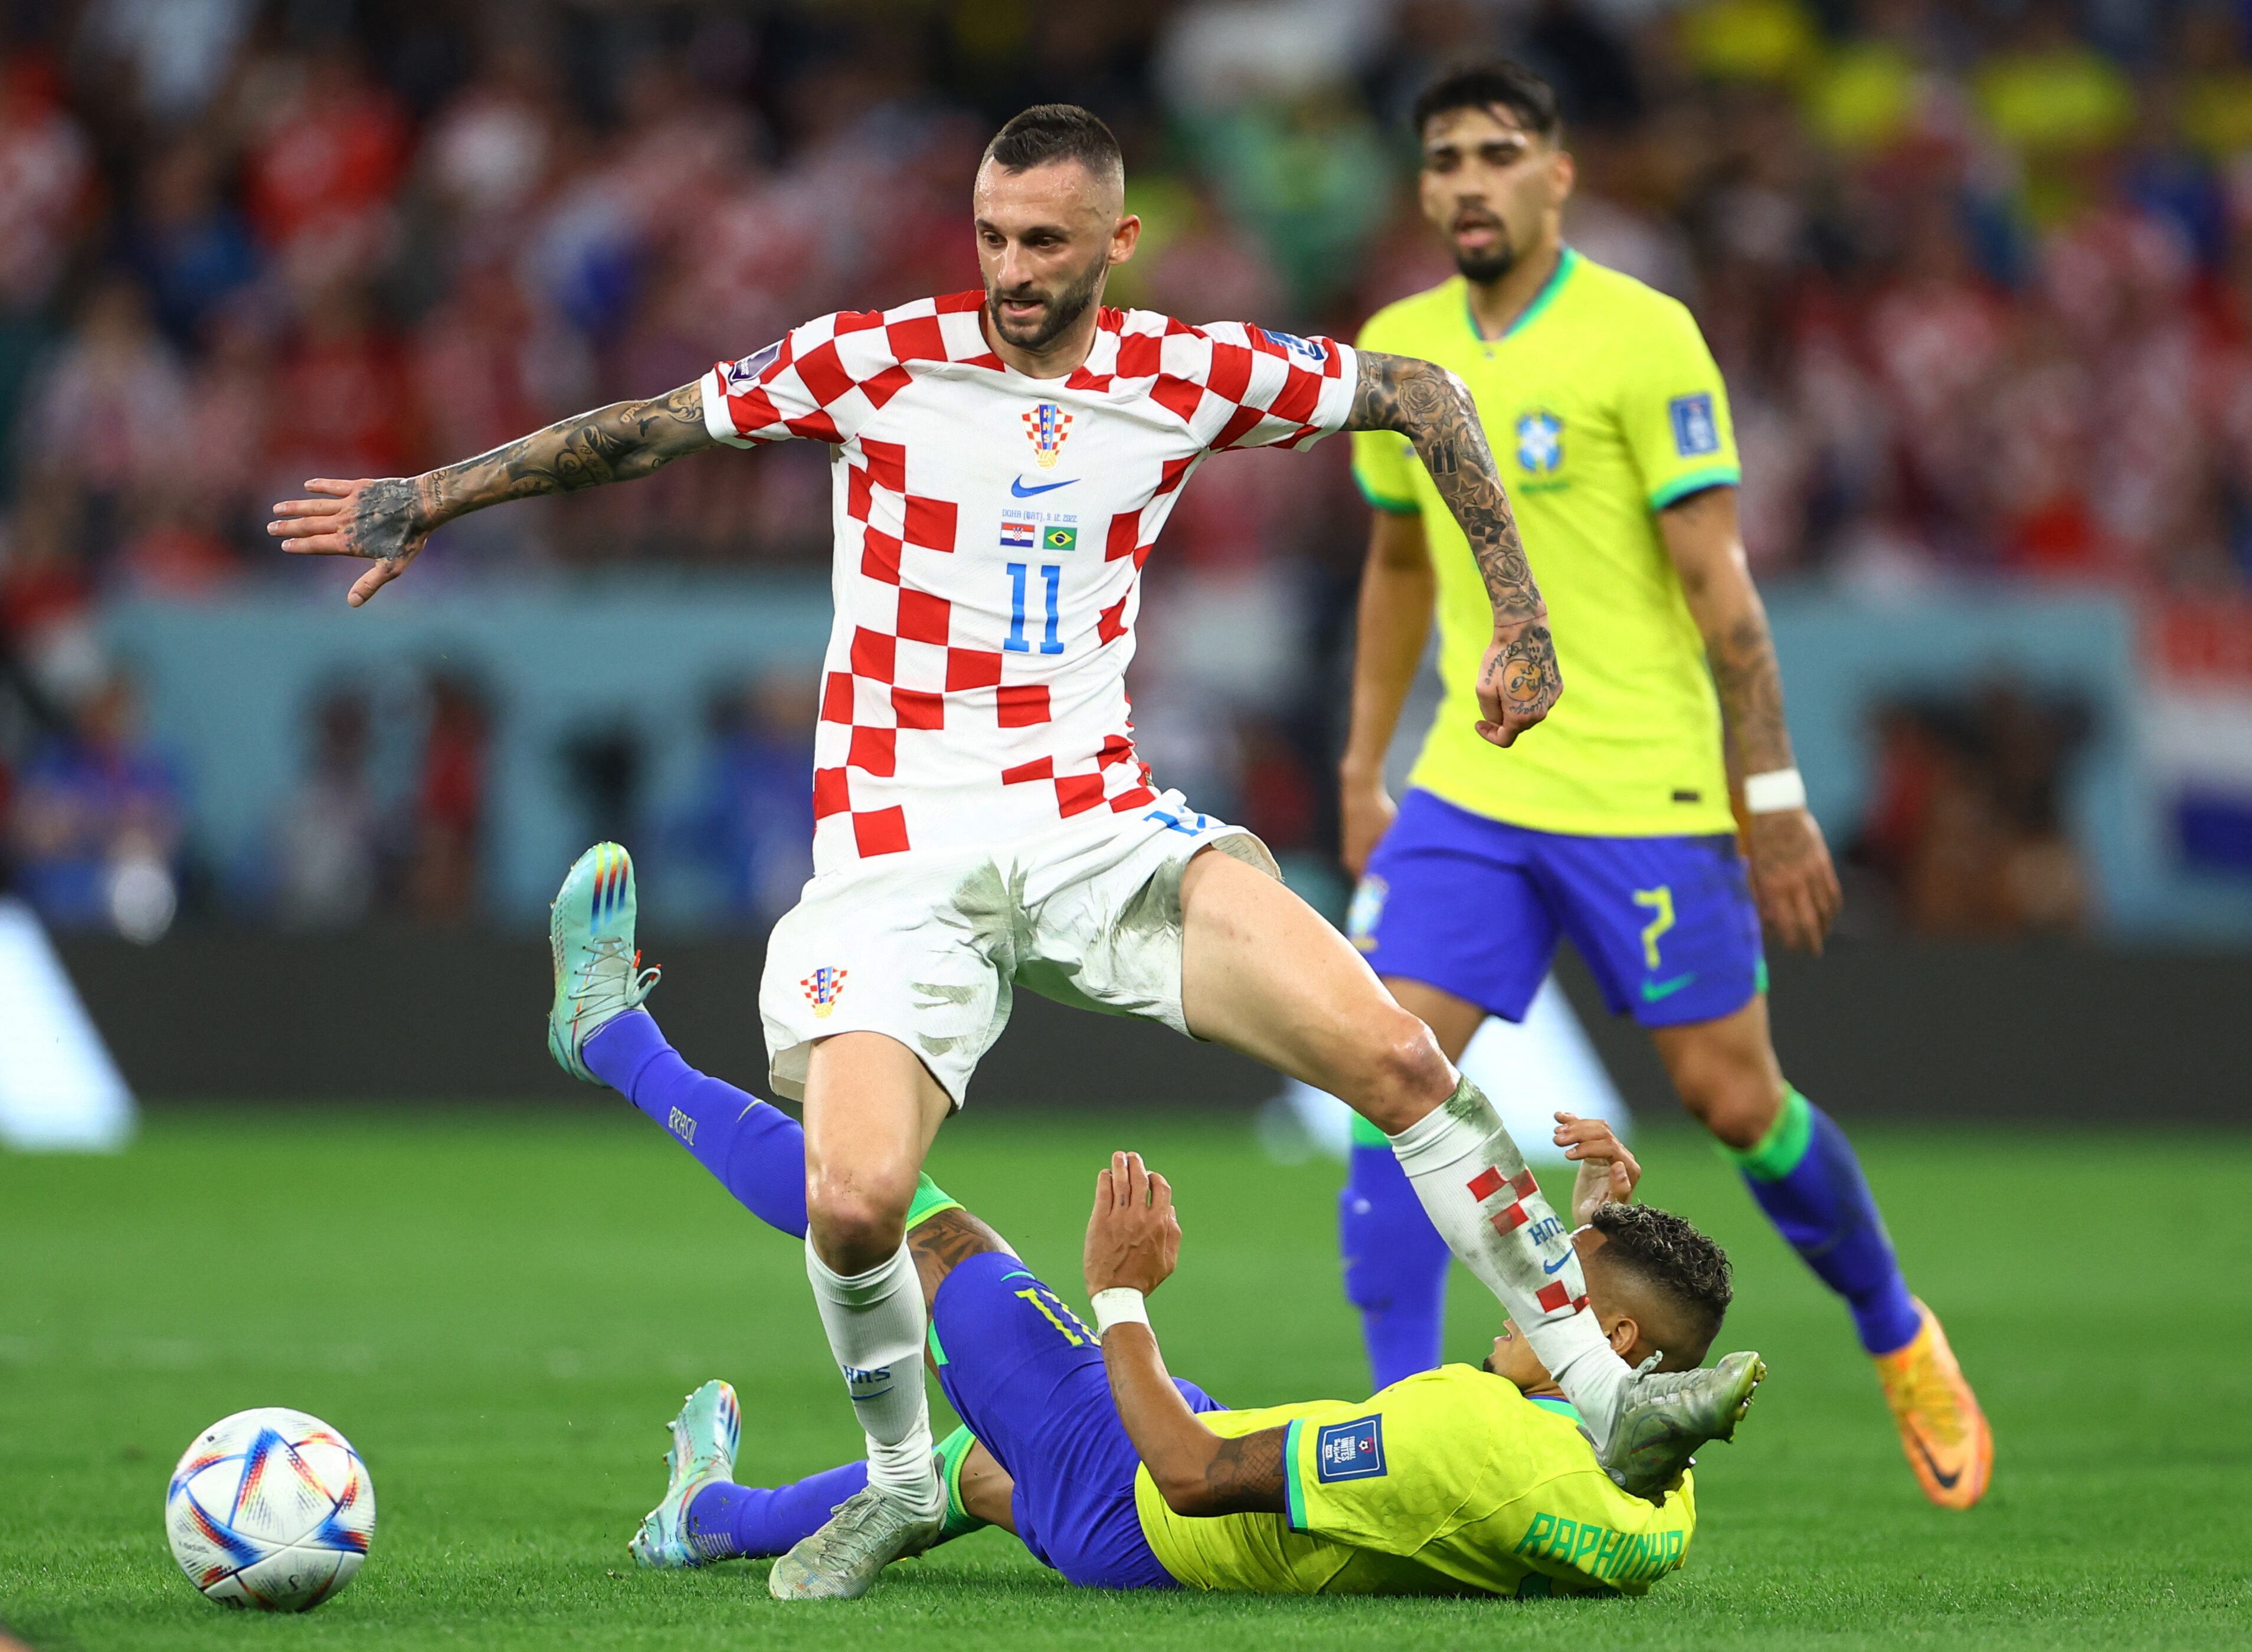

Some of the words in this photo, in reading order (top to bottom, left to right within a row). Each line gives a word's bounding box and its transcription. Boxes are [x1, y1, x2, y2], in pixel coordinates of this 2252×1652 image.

[1003, 509, 1022, 518] DOHA
[1004, 562, 1064, 654] 11
[1633, 885, 1676, 971] 7
[1340, 1437, 1350, 1461] UNITES
[1513, 1512, 1683, 1579] RAPHINHA
